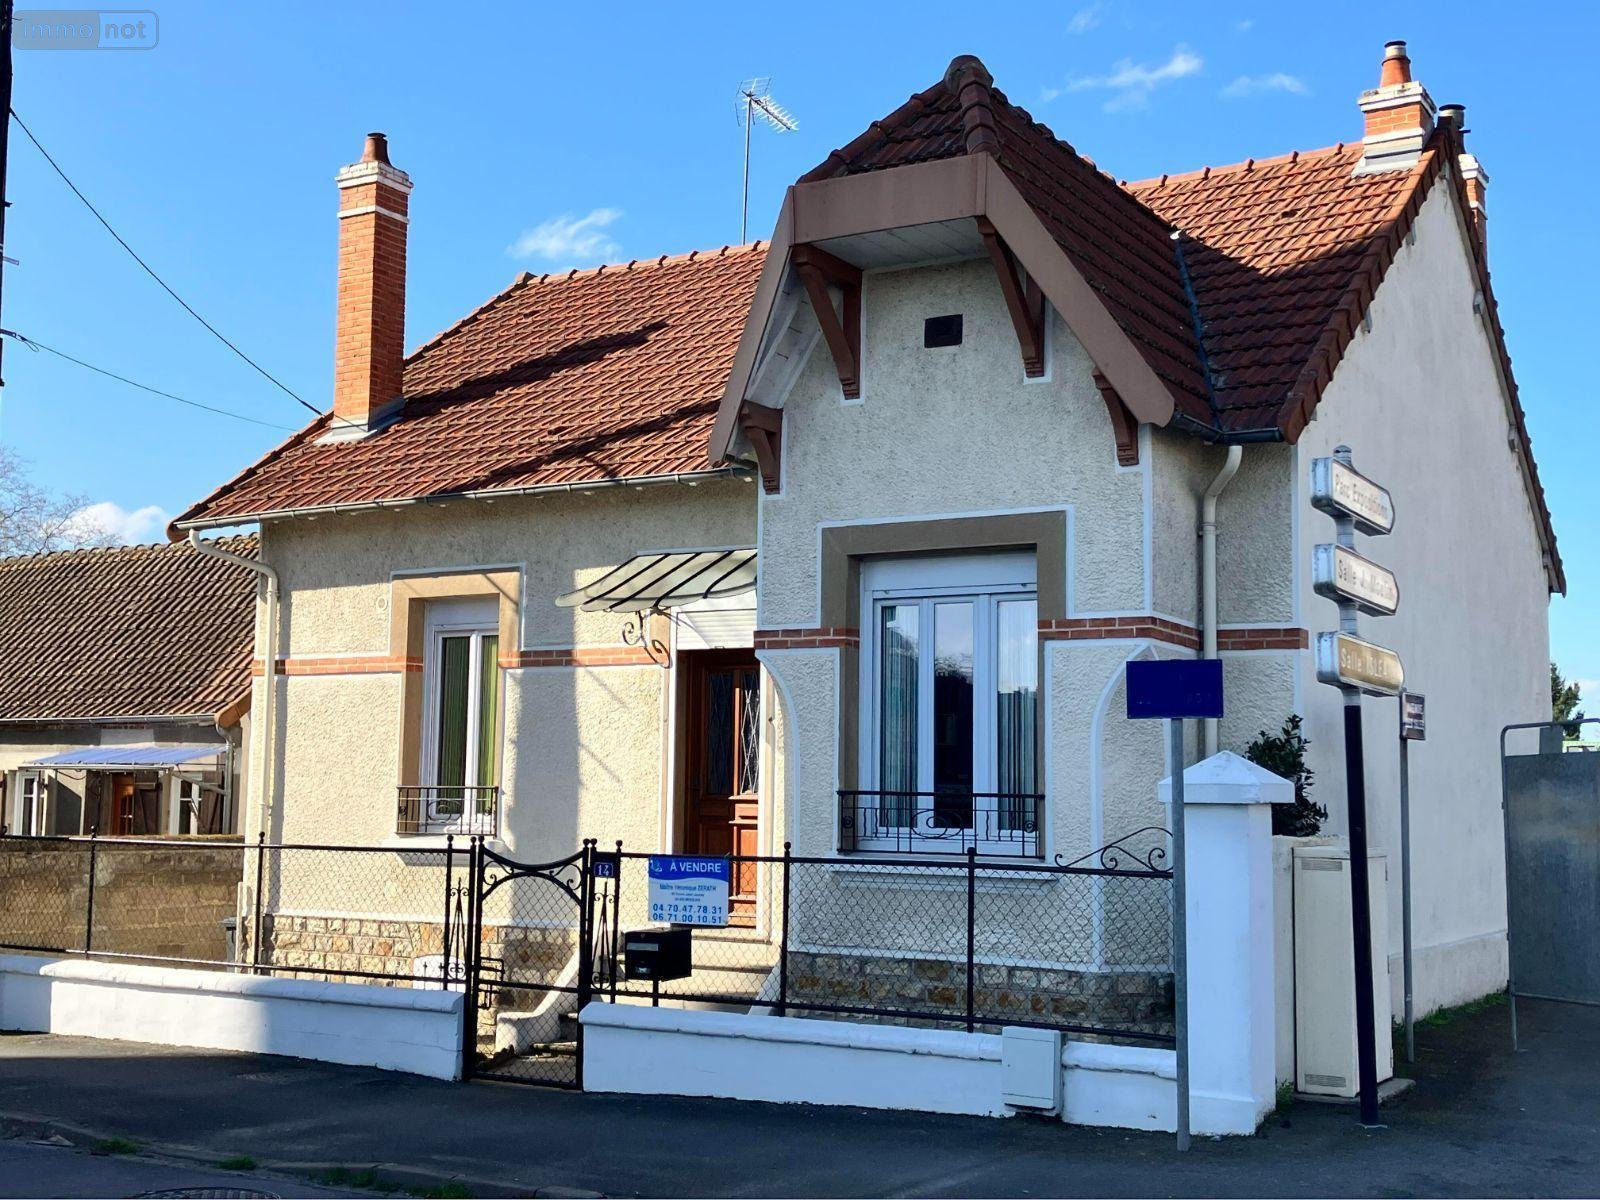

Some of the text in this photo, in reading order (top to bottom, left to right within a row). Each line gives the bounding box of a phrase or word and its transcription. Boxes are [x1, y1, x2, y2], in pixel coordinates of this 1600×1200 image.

[1338, 559, 1357, 586] Salle
[1341, 647, 1362, 673] Salle
[679, 862, 722, 873] VENDRE
